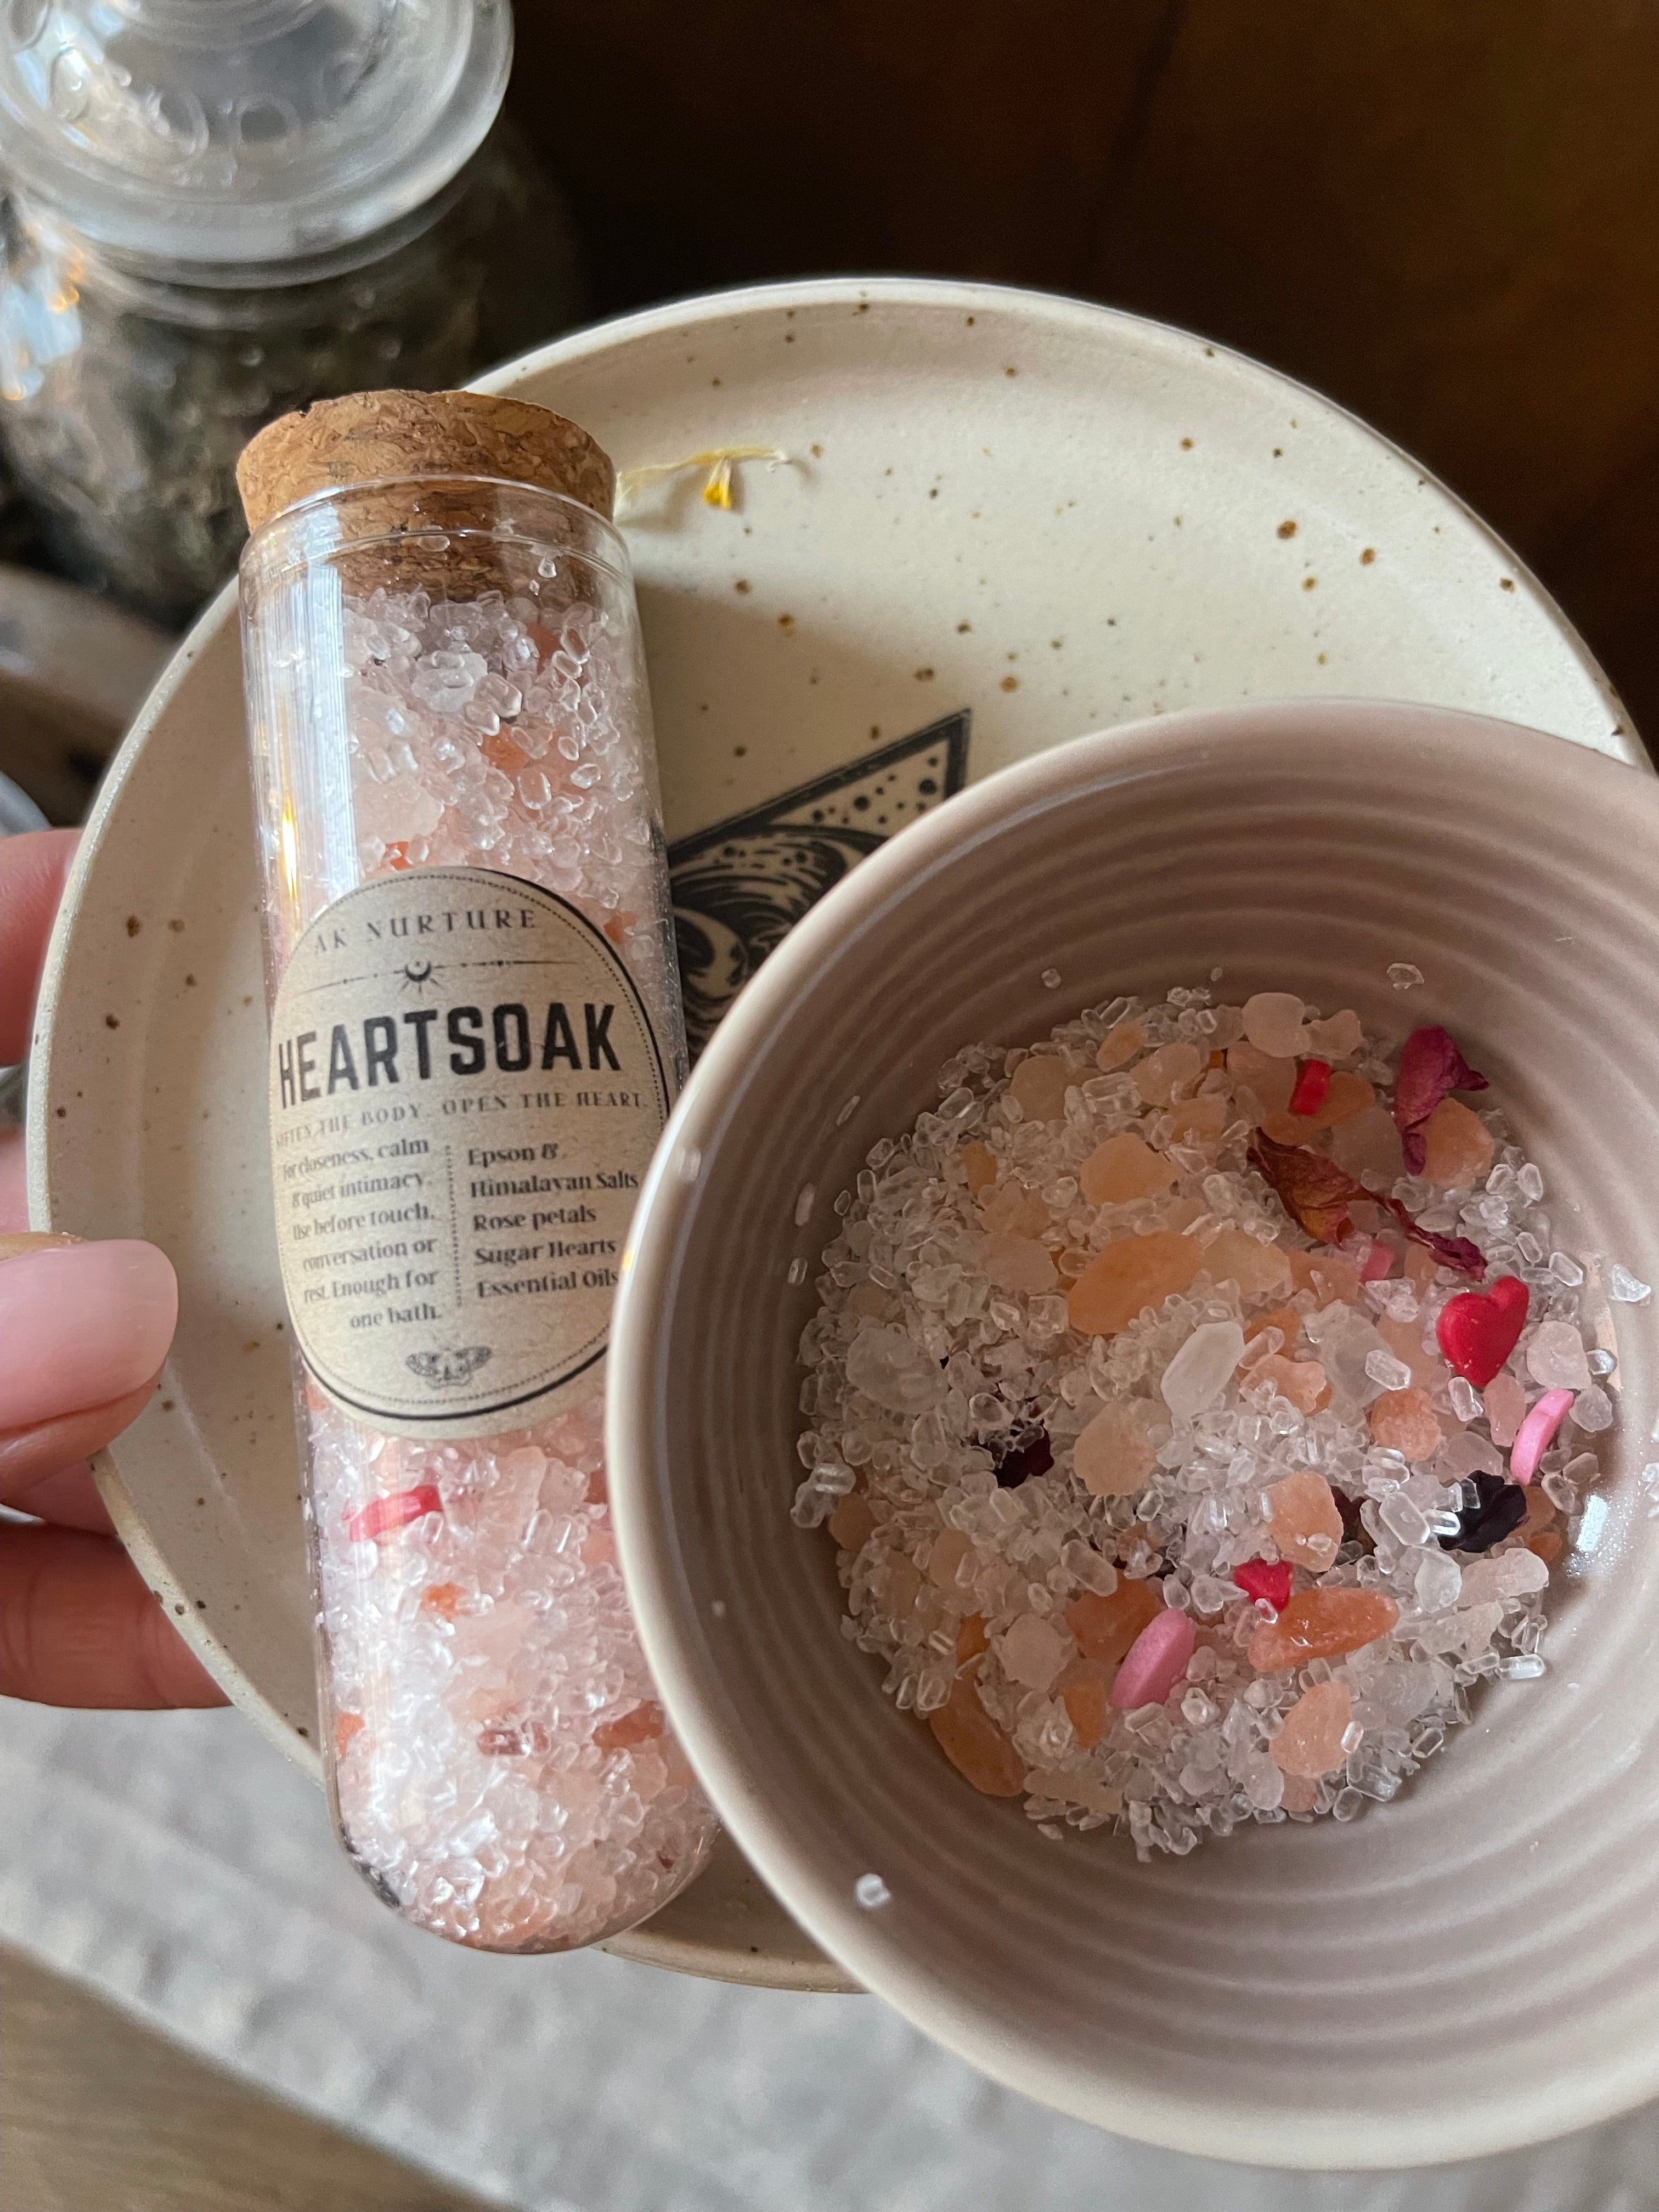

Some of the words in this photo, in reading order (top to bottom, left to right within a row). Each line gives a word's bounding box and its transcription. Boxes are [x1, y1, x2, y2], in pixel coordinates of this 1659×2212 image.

[314, 929, 347, 956] AK
[366, 909, 537, 942] NURTURE
[279, 1002, 622, 1109] HEARTSOAK
[442, 1093, 509, 1115] OPEN
[519, 1091, 566, 1109] THE
[377, 1138, 430, 1158] calm
[467, 1147, 537, 1167] Epson
[301, 1184, 336, 1209] quiet
[470, 1175, 592, 1198] Himalayan
[595, 1169, 640, 1189] Salts
[313, 1214, 366, 1235] before
[473, 1212, 526, 1232] Rose
[532, 1204, 597, 1231] petals
[302, 1240, 408, 1272] conversation
[414, 1237, 438, 1254] or
[474, 1245, 544, 1266] Sugar
[548, 1238, 617, 1259] Hearts
[331, 1273, 400, 1297] Enough
[404, 1268, 440, 1289] for
[477, 1271, 577, 1298] Essential
[582, 1267, 620, 1288] Oils
[350, 1312, 384, 1329] one
